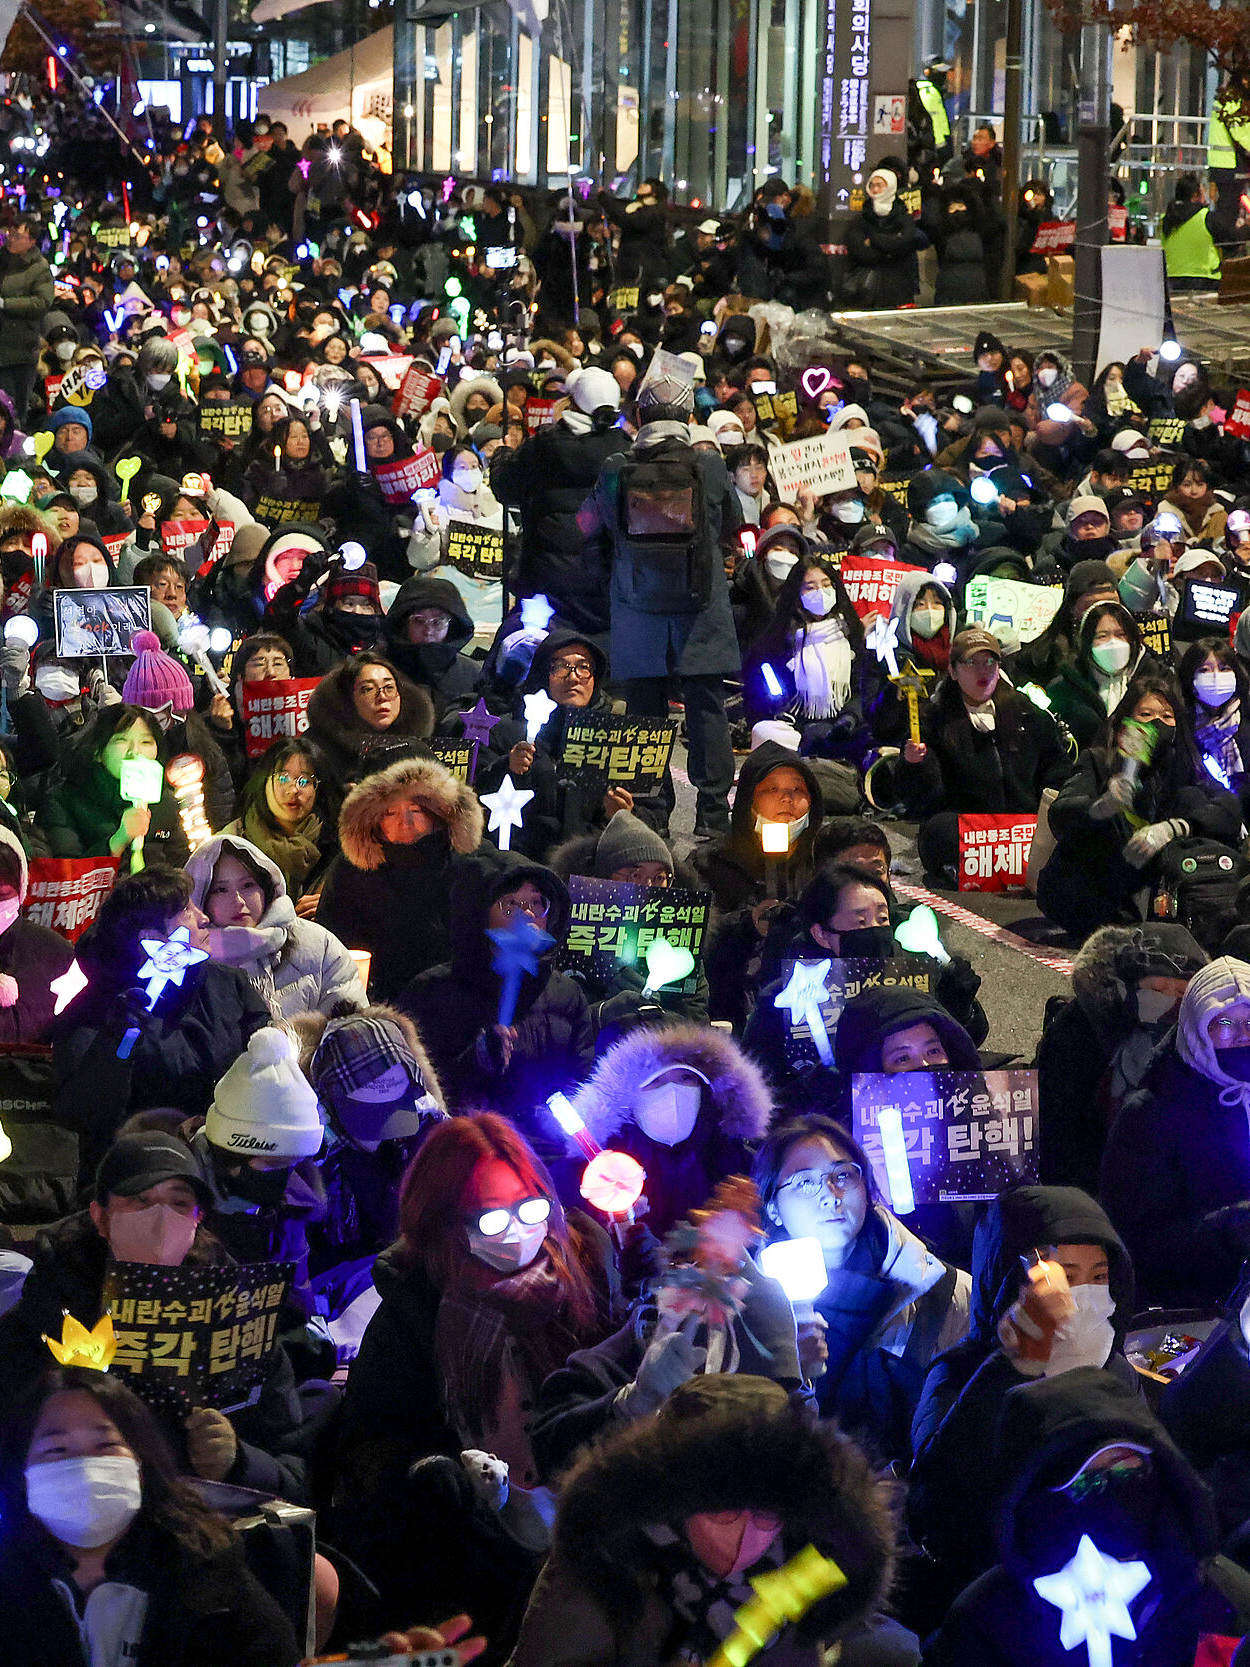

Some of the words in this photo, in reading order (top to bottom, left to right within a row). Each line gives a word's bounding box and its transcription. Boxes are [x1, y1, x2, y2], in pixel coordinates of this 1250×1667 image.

[450, 532, 481, 546] 내란수괴
[448, 543, 476, 562] 즉각
[843, 569, 883, 581] 내란동조
[248, 695, 297, 713] 내란동조
[568, 727, 622, 745] 내란수괴
[637, 729, 674, 745] 윤석열
[563, 744, 609, 770] 즉각
[608, 744, 672, 781] 탄핵
[964, 828, 1010, 845] 내란동조
[32, 880, 83, 899] 내란동조
[571, 903, 638, 923] 내란수괴
[659, 906, 706, 924] 윤석열
[567, 925, 627, 958] 즉각
[971, 1088, 1032, 1117] 윤석열
[947, 1116, 1032, 1163] 탄핵!
[111, 1298, 213, 1327] 내란수괴
[235, 1281, 287, 1319] 윤석열
[114, 1330, 197, 1377] 즉각
[210, 1312, 279, 1376] 탄핵!
